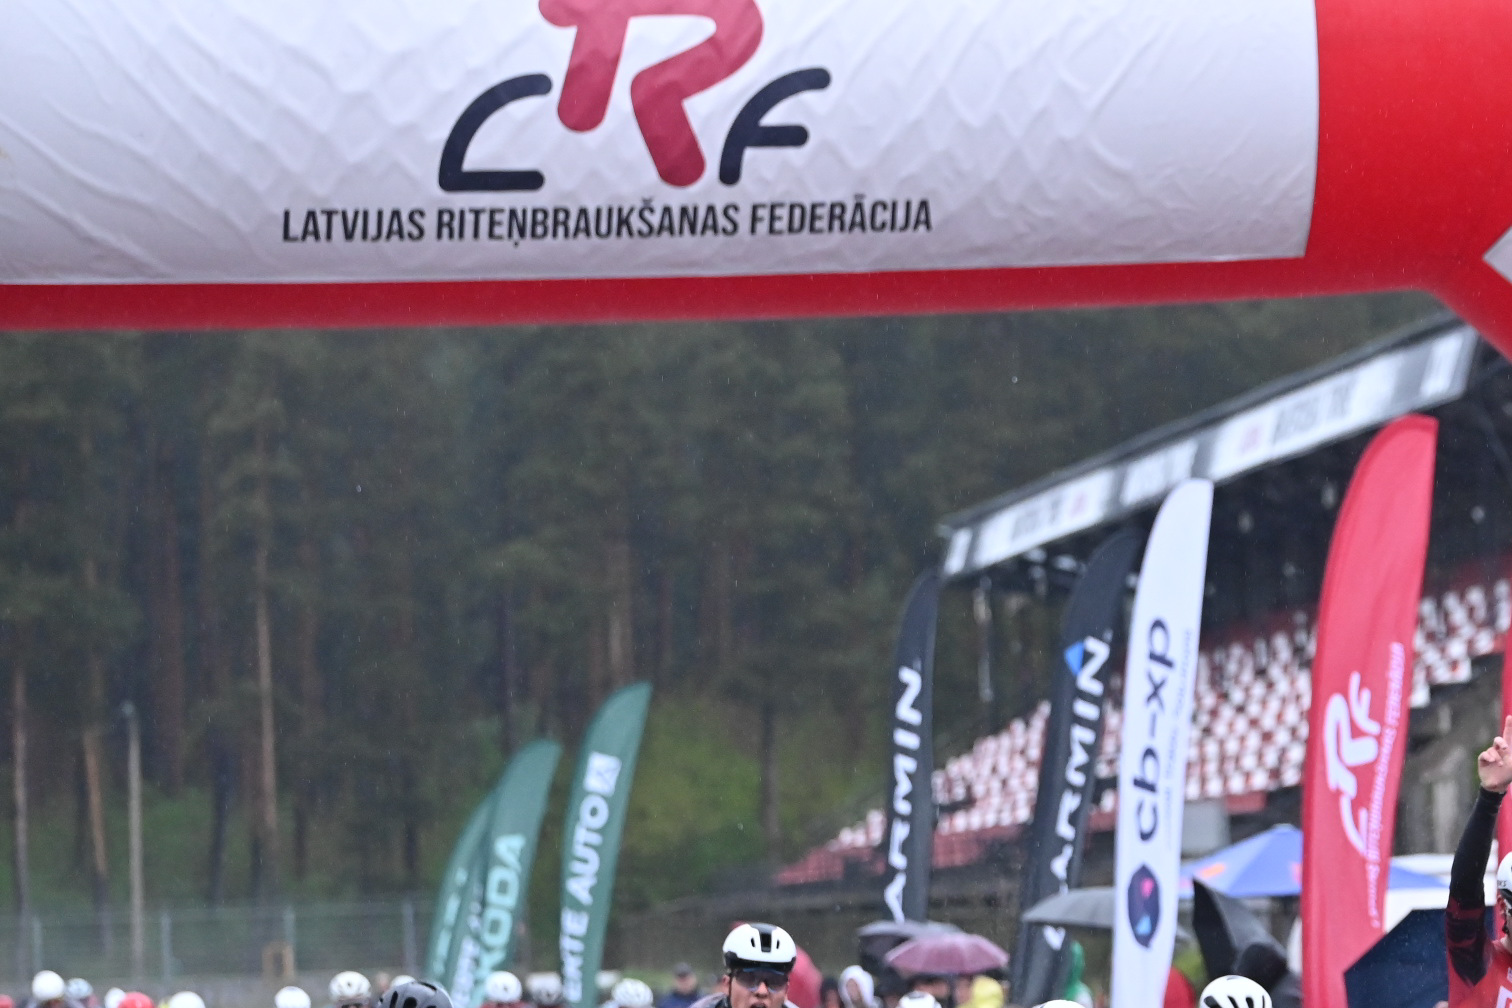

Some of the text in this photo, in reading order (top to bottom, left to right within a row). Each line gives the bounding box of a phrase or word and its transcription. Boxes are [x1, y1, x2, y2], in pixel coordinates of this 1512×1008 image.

[282, 195, 932, 248] LATVIJAS RITEŅBRAUKŠANAS FEDERĀCIJA
[566, 793, 611, 906] AUTO
[883, 664, 924, 924] ARMIN
